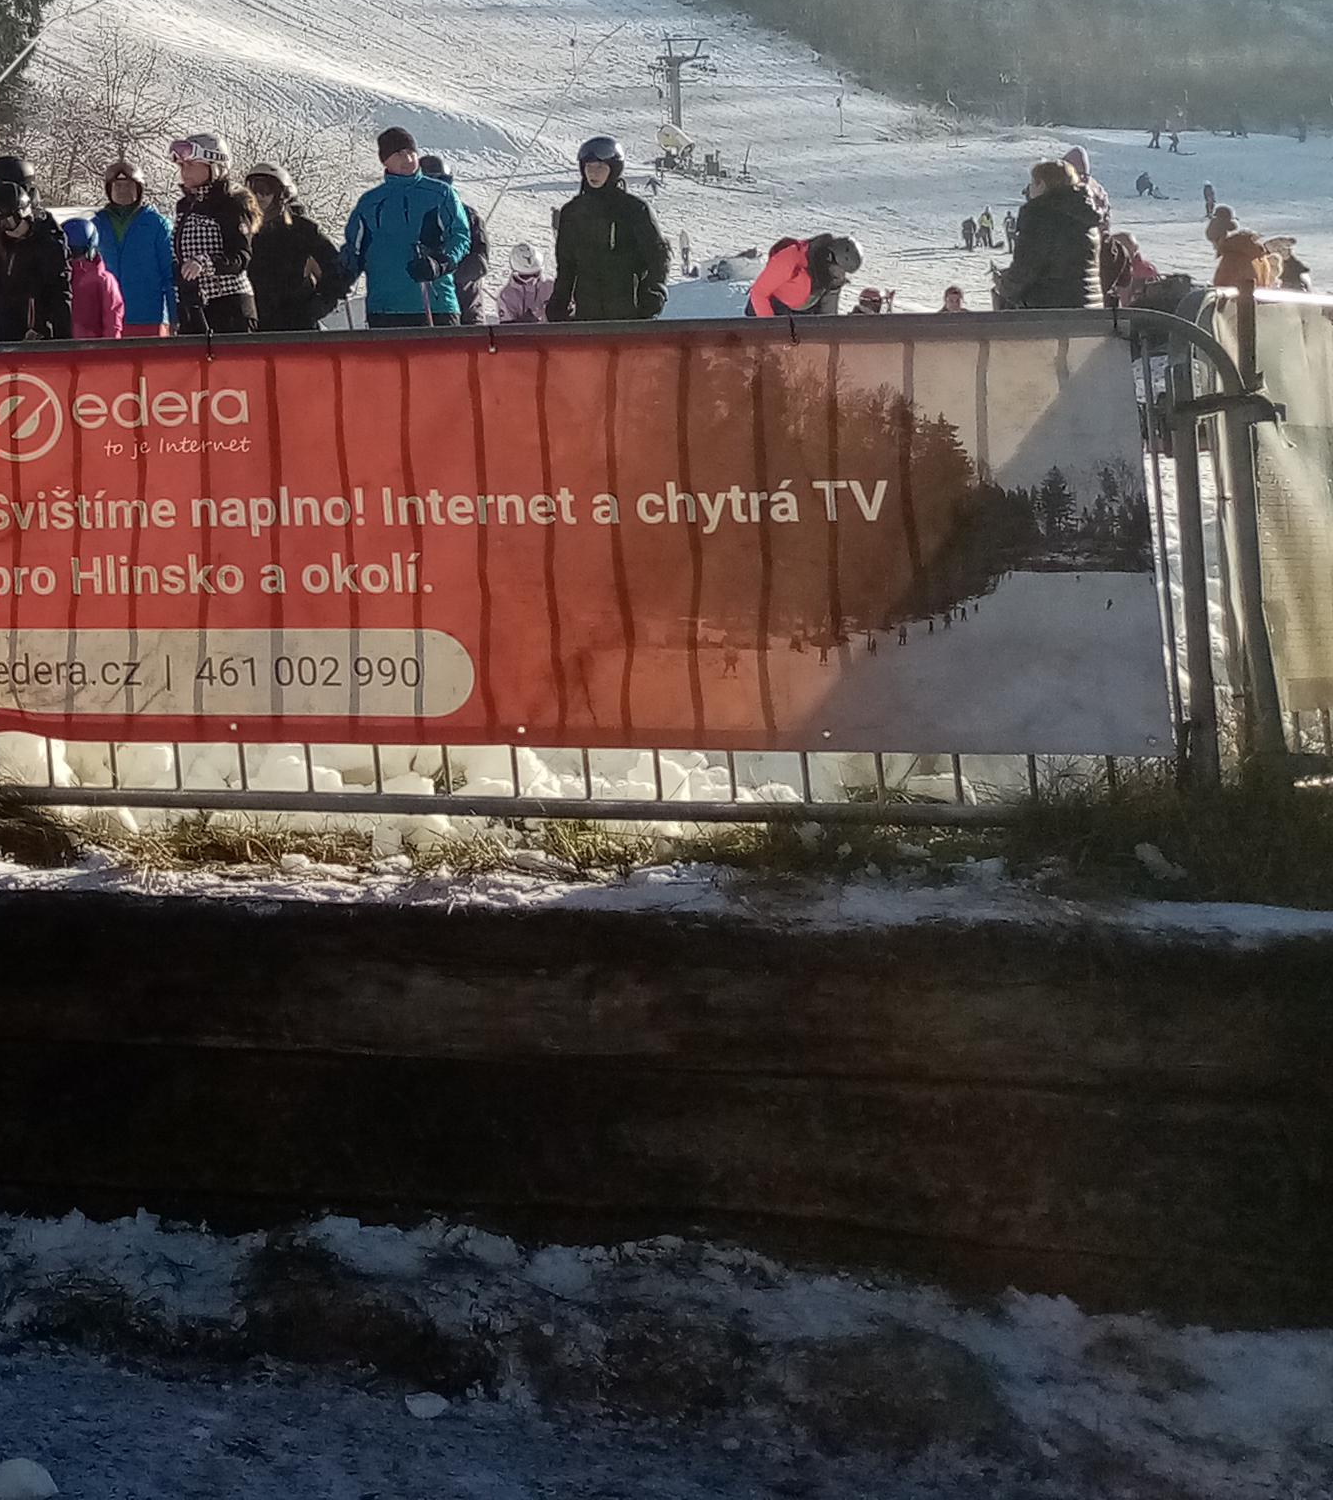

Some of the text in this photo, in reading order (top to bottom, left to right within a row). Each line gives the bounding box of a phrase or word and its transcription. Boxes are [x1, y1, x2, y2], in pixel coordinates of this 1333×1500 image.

[71, 376, 249, 431] edera
[104, 435, 251, 461] to je Internet
[191, 486, 365, 537] naplno!
[382, 485, 577, 527] Internet
[591, 488, 620, 524] a
[636, 479, 800, 535] chytrá
[813, 479, 888, 523] TV
[71, 554, 245, 596] Hlinsko
[260, 562, 286, 594] a
[302, 552, 433, 595] okolí.
[194, 655, 259, 687] 461
[274, 655, 342, 688] 002
[354, 655, 422, 688] 990
